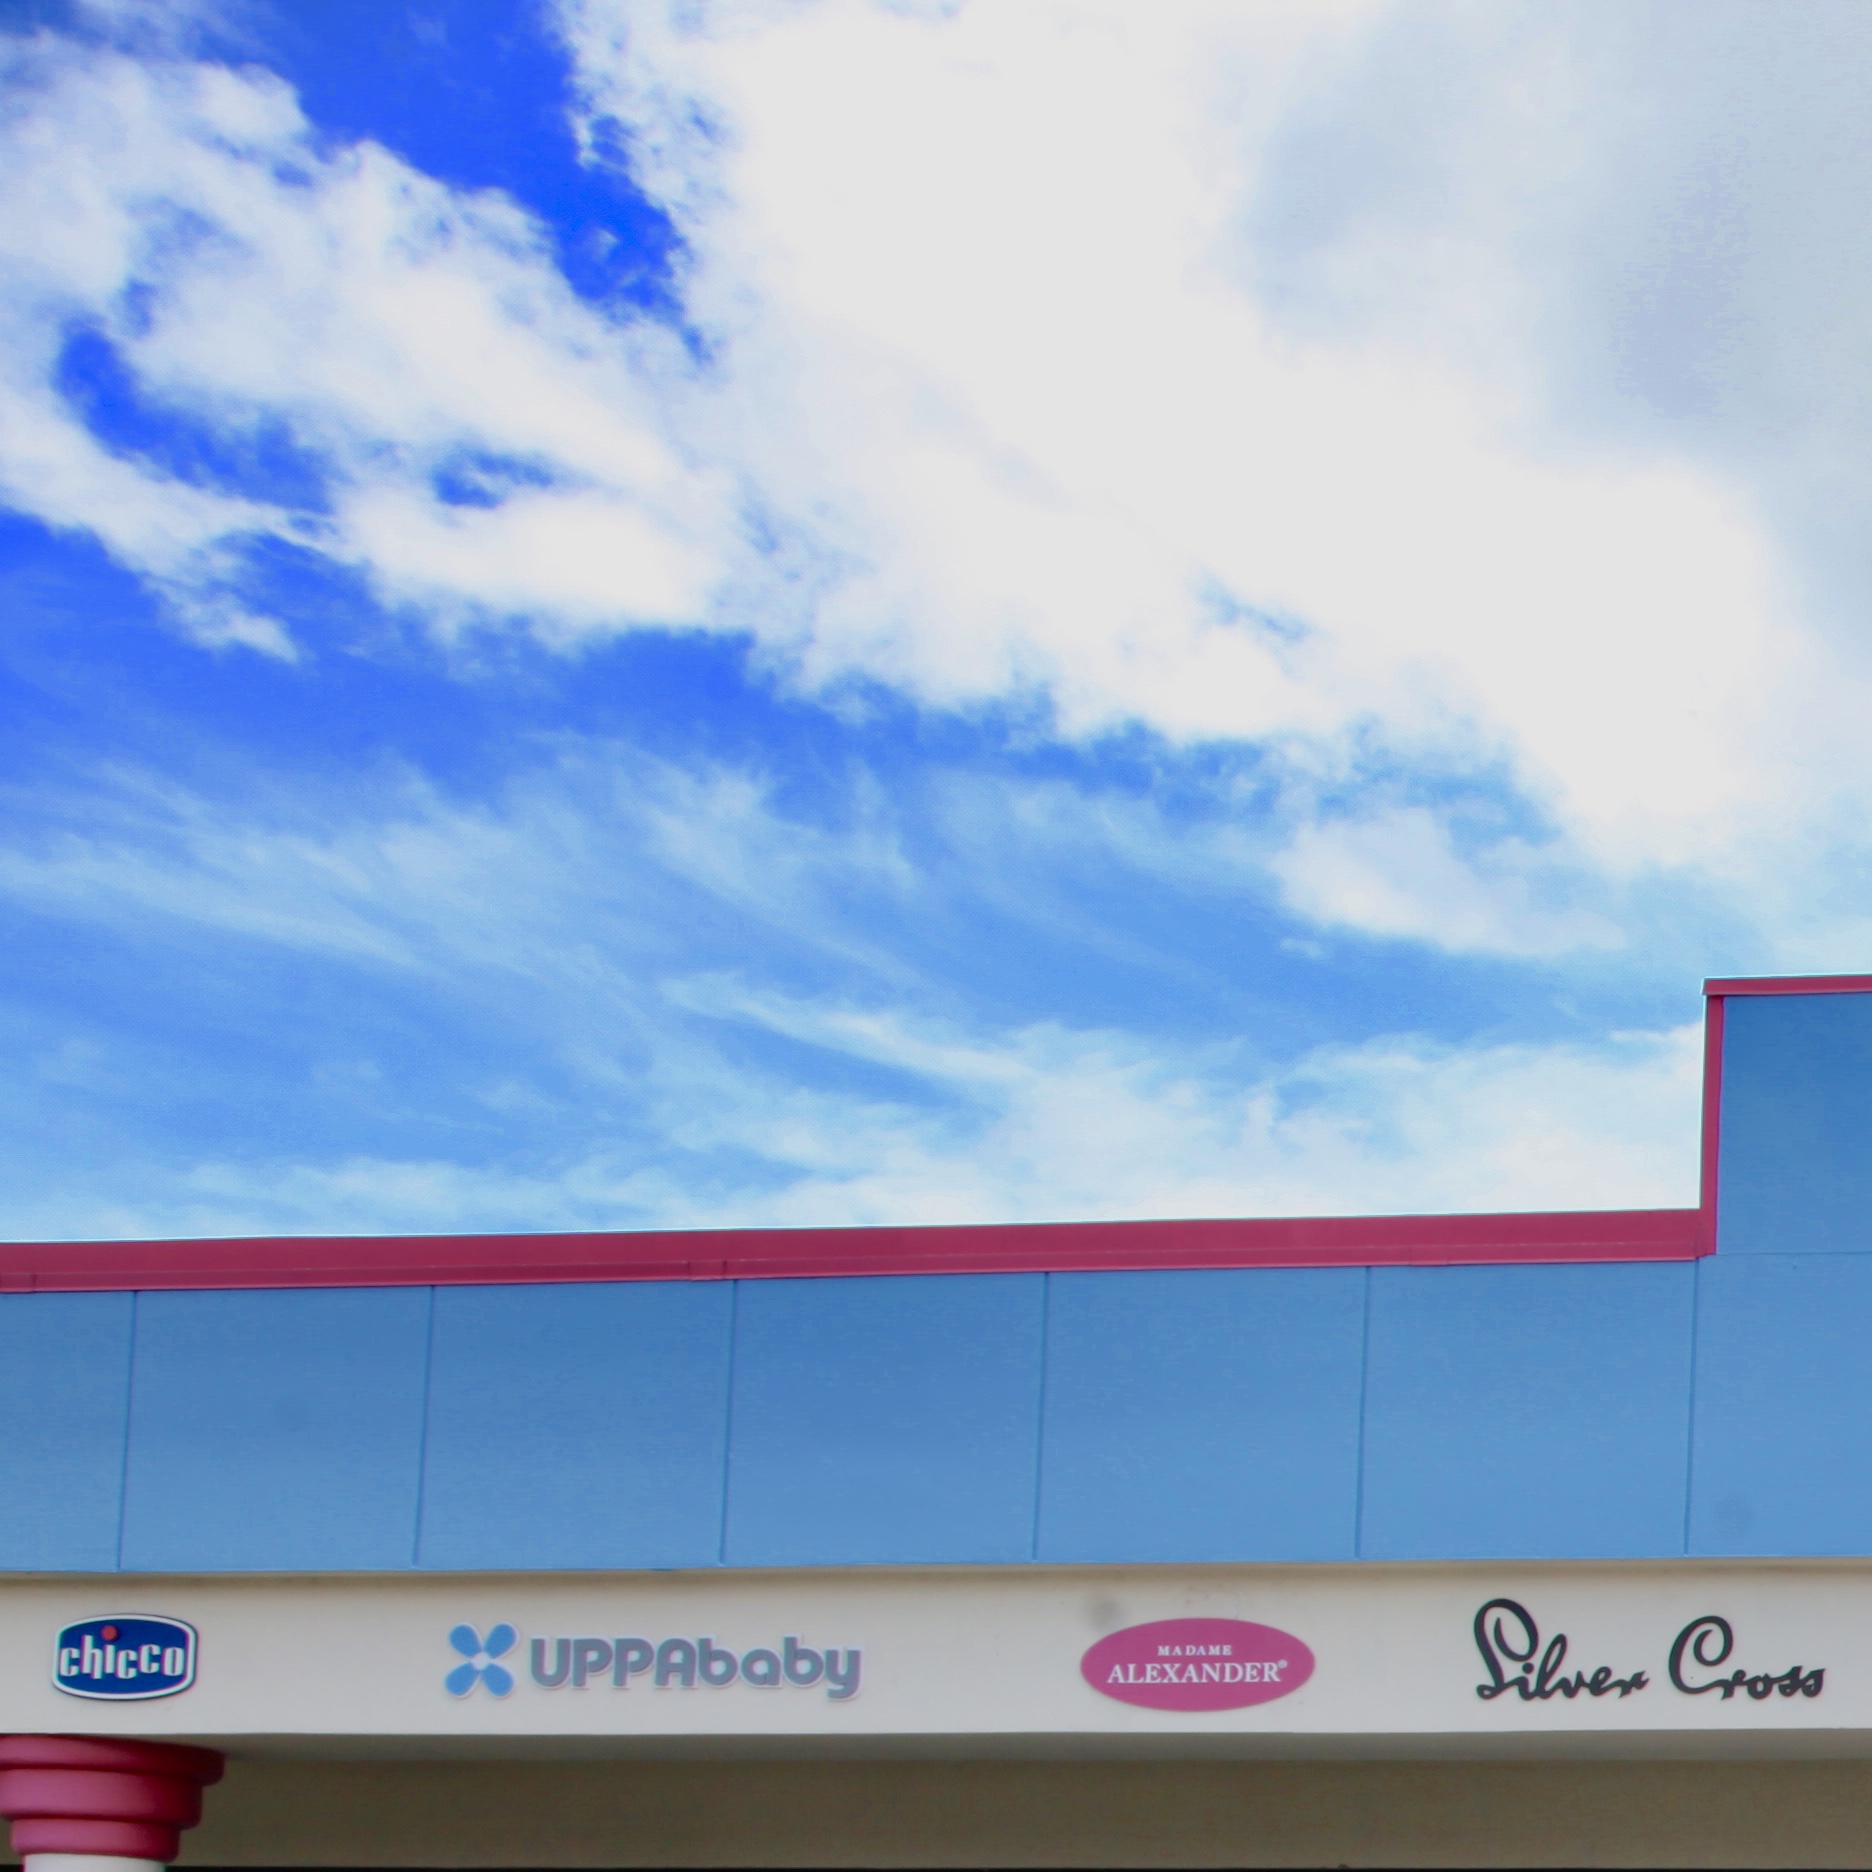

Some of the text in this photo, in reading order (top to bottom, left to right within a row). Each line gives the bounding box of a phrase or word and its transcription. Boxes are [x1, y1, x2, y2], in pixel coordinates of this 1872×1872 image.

[59, 1626, 185, 1680] chicco
[530, 1635, 863, 1699] UPPAbaby
[1157, 1645, 1233, 1656] MADAME
[1474, 1598, 1826, 1701] Silver Cross
